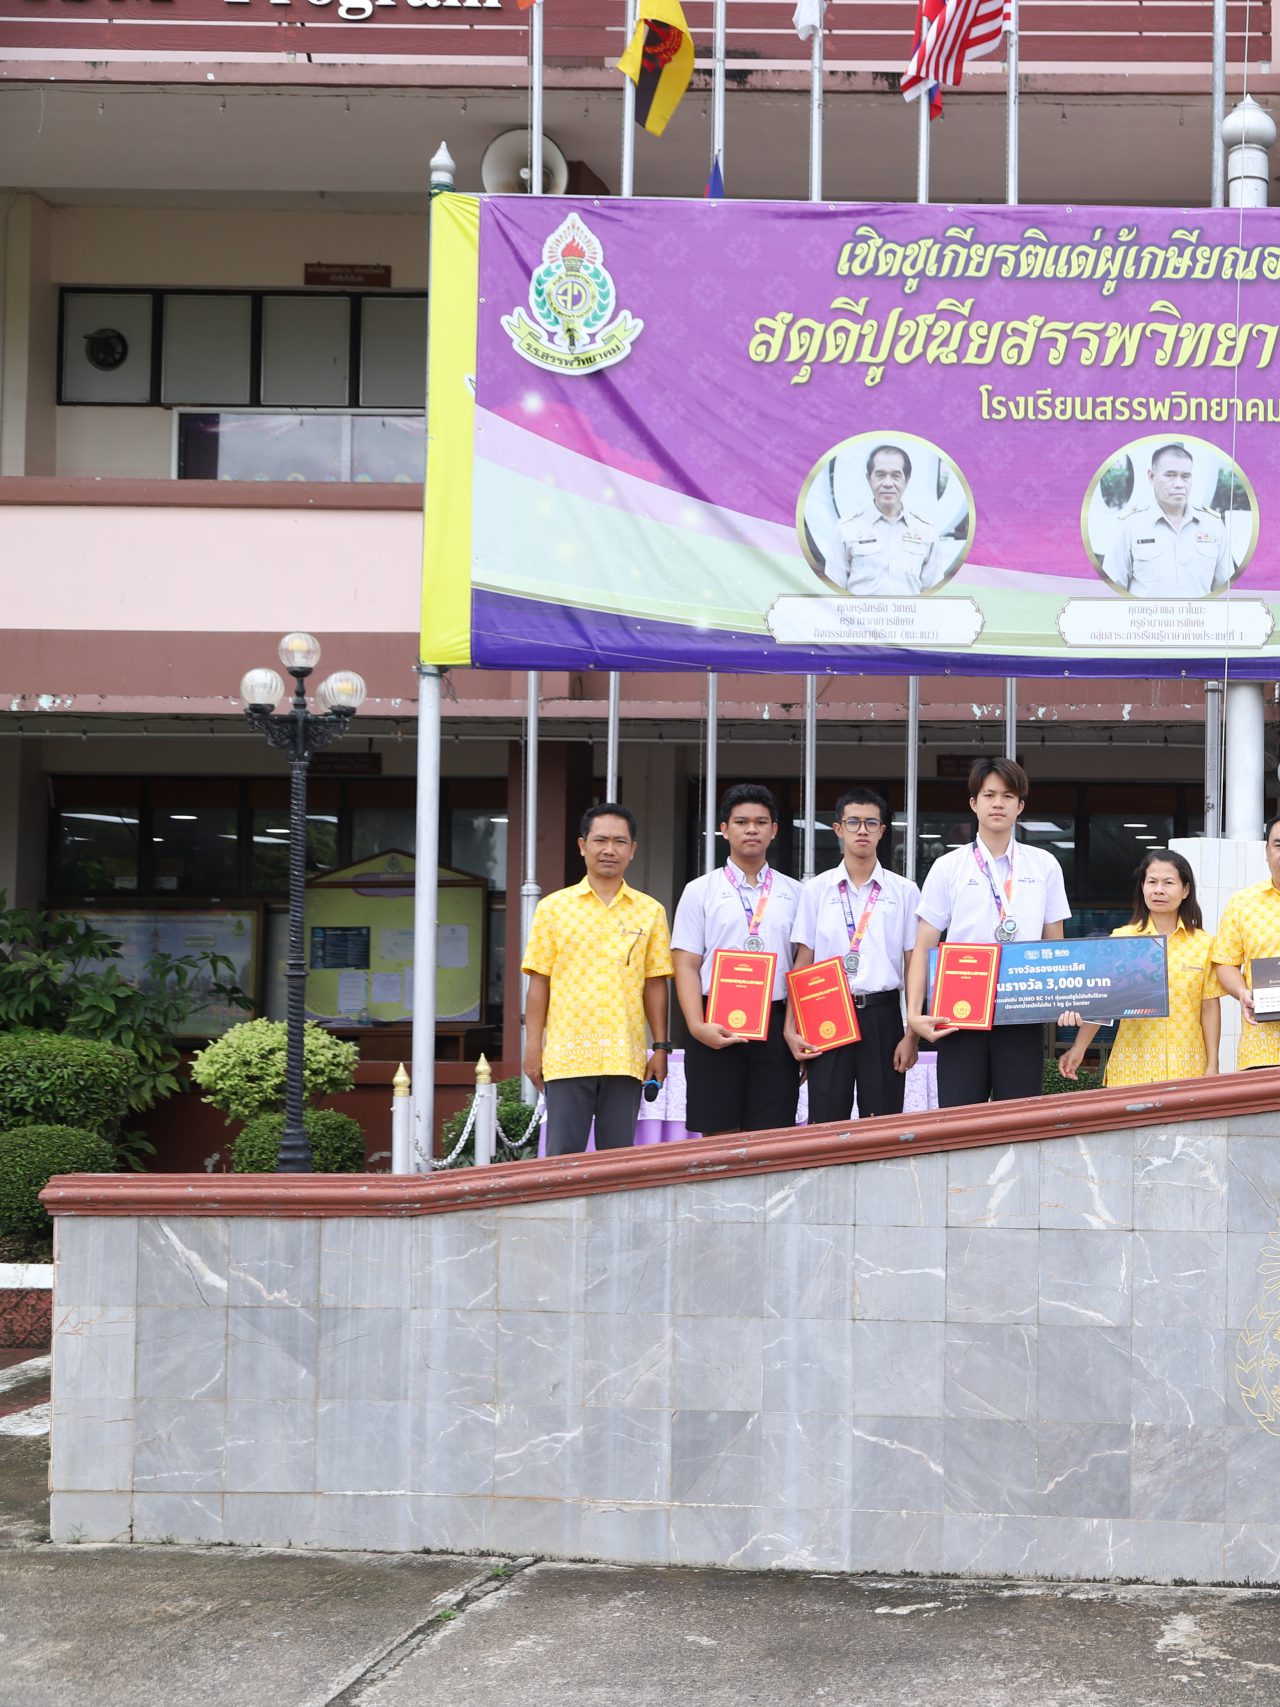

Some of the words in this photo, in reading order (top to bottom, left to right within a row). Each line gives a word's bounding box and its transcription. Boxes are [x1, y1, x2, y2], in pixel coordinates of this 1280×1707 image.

[1238, 632, 1244, 641] 1
[1008, 962, 1086, 975] รางวัลรองชนะเลิศ
[997, 978, 1043, 992] นรางวัล
[1046, 976, 1083, 991] 3,000
[1086, 977, 1111, 988] บาท
